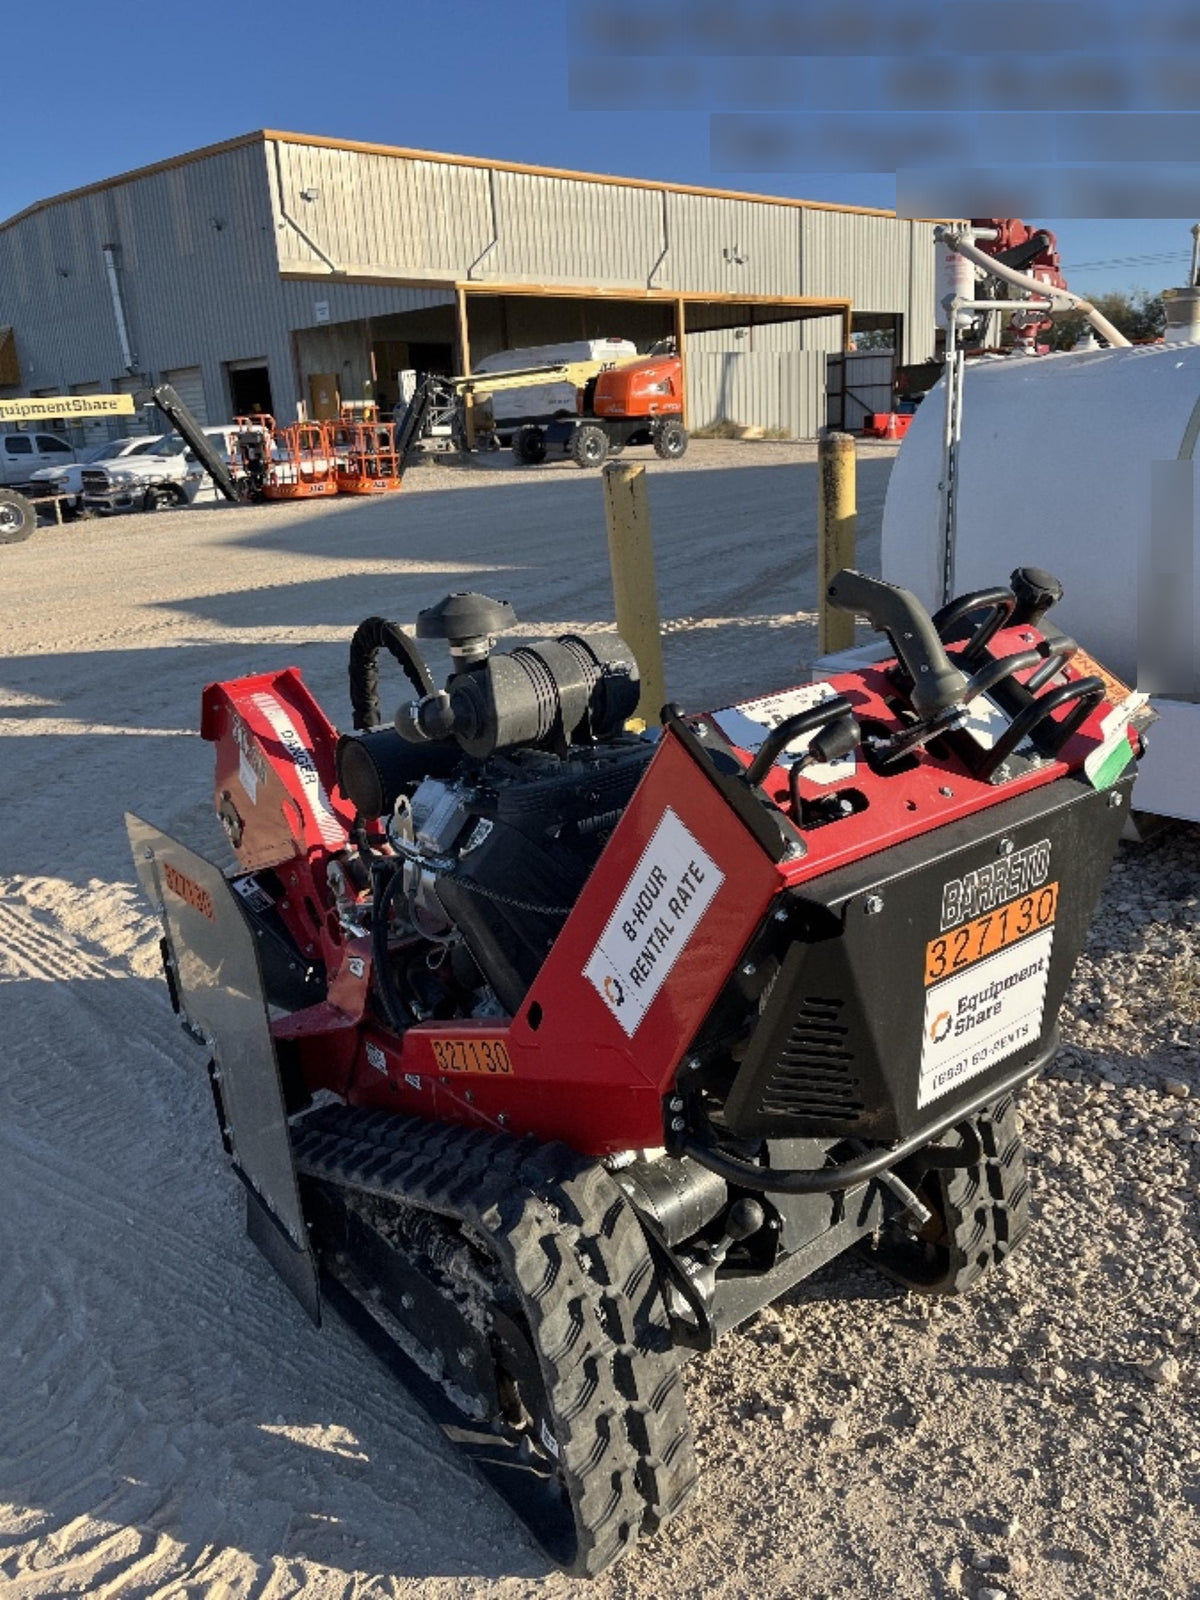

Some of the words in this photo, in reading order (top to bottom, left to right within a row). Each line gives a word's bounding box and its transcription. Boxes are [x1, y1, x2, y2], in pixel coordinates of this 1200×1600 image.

[281, 729, 317, 785] DANGER
[622, 864, 668, 942] 8-HOUR
[940, 838, 1052, 932] BARRETO
[629, 917, 675, 988] RENTAL
[667, 859, 705, 920] RATE
[929, 888, 1054, 978] 327130
[954, 1000, 1003, 1037] Share
[956, 957, 1044, 1017] Equipment
[433, 1041, 510, 1073] 327130
